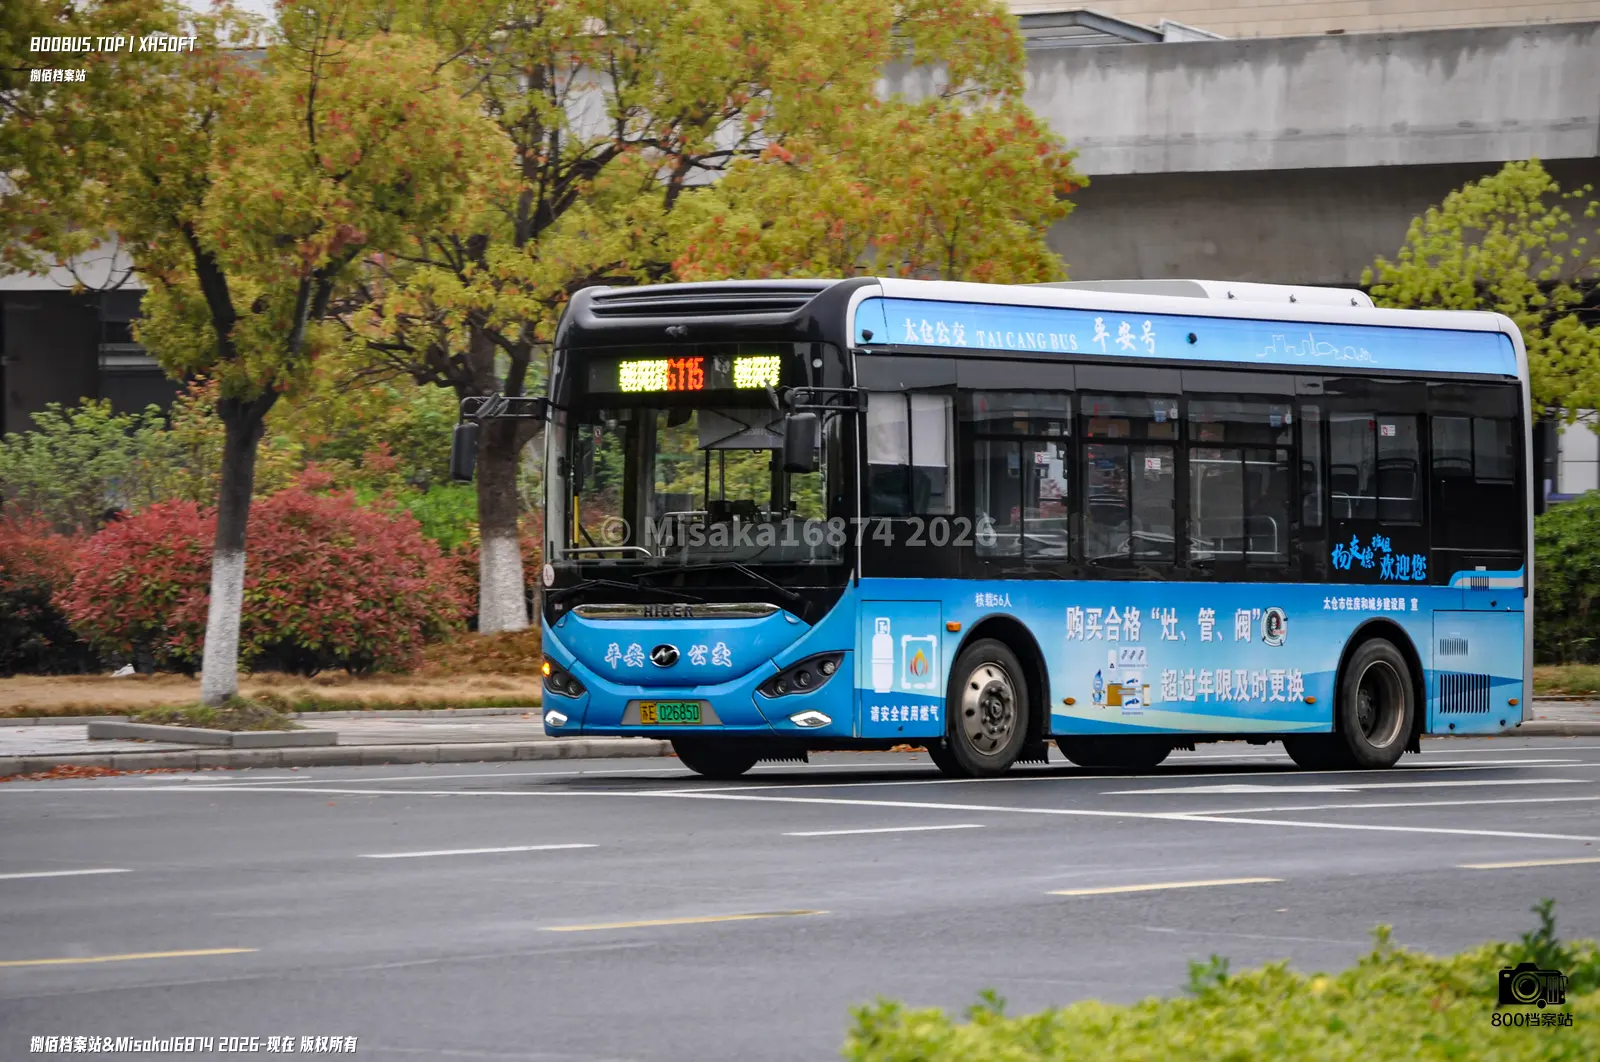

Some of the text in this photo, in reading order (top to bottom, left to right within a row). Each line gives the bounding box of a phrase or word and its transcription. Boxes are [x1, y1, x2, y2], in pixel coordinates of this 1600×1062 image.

[902, 318, 968, 346] 太仓公交
[1049, 332, 1079, 351] BUS
[1092, 316, 1157, 353] 平安号
[1380, 553, 1427, 581] 欢迎您
[644, 604, 694, 618] HIGER
[975, 592, 1012, 608] 核载56人
[1323, 596, 1406, 612] 太仓市住房和城乡建设局
[604, 642, 732, 669] 平安 公交
[1160, 668, 1305, 703] 超过年限及时更换
[870, 705, 940, 722] 请安全使用燃气
